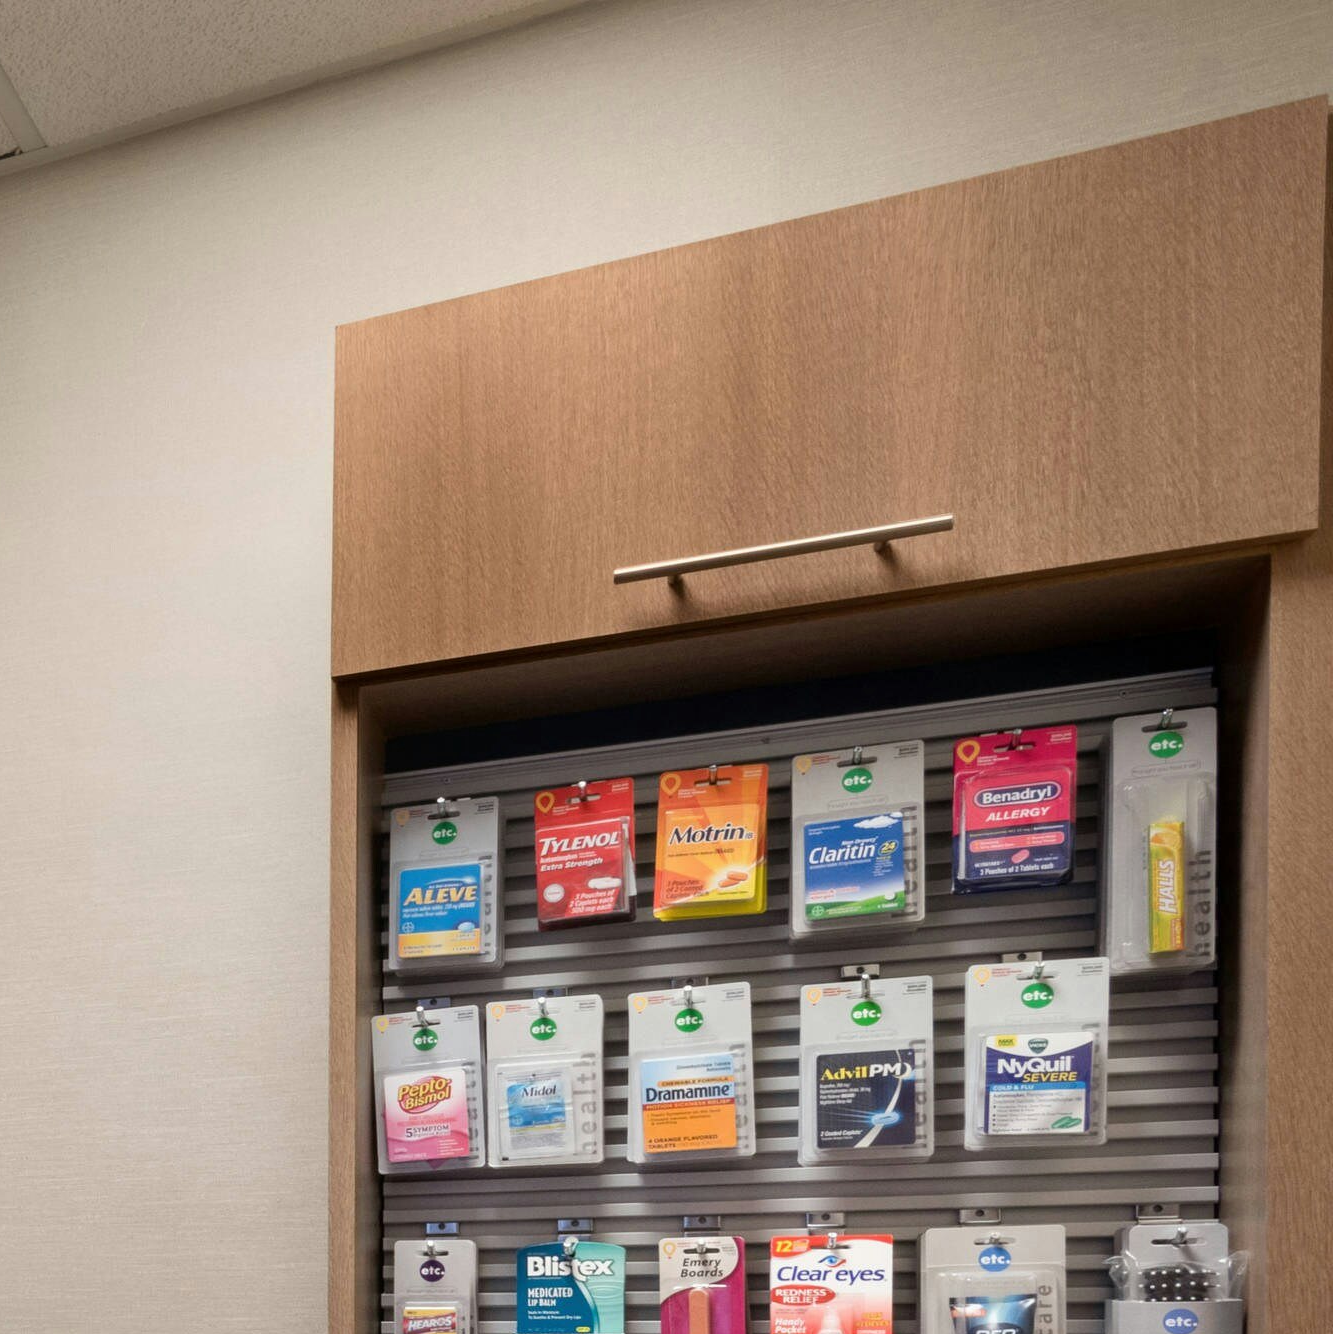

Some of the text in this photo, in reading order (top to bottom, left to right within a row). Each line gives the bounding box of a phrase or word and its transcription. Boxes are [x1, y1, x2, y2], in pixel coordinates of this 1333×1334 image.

[1151, 740, 1184, 751] etc.
[843, 776, 872, 786] etc.
[982, 786, 1052, 805] Benadryl
[985, 806, 1051, 822] ALLERGY
[433, 828, 457, 838] etc.
[669, 823, 744, 845] Motrin
[539, 832, 620, 855] TYLENOL
[808, 841, 897, 865] Claritin 24
[541, 857, 603, 871] Extra Strength
[1158, 860, 1178, 914] HALLS
[404, 886, 477, 905] ALEVE
[532, 1026, 557, 1034] etc.
[414, 1037, 438, 1045] etc.
[821, 1063, 901, 1081] Advil PM
[997, 1056, 1072, 1078] NyQuil
[1022, 1071, 1078, 1083] SEVERE
[522, 1085, 557, 1098] Midol
[645, 1085, 729, 1102] Dramamine
[405, 1089, 451, 1110] Bismol
[776, 1241, 792, 1252] 12
[527, 1256, 613, 1281] Blistex
[682, 1257, 721, 1269] Emery
[681, 1266, 723, 1278] Boards
[777, 1266, 885, 1285] Clear eyes
[528, 1288, 573, 1298] MEDICATED
[528, 1299, 556, 1307] LIP BALM
[408, 1317, 452, 1331] HEAROS
[775, 1318, 805, 1326] Handy
[775, 1326, 806, 1334] Pocket
